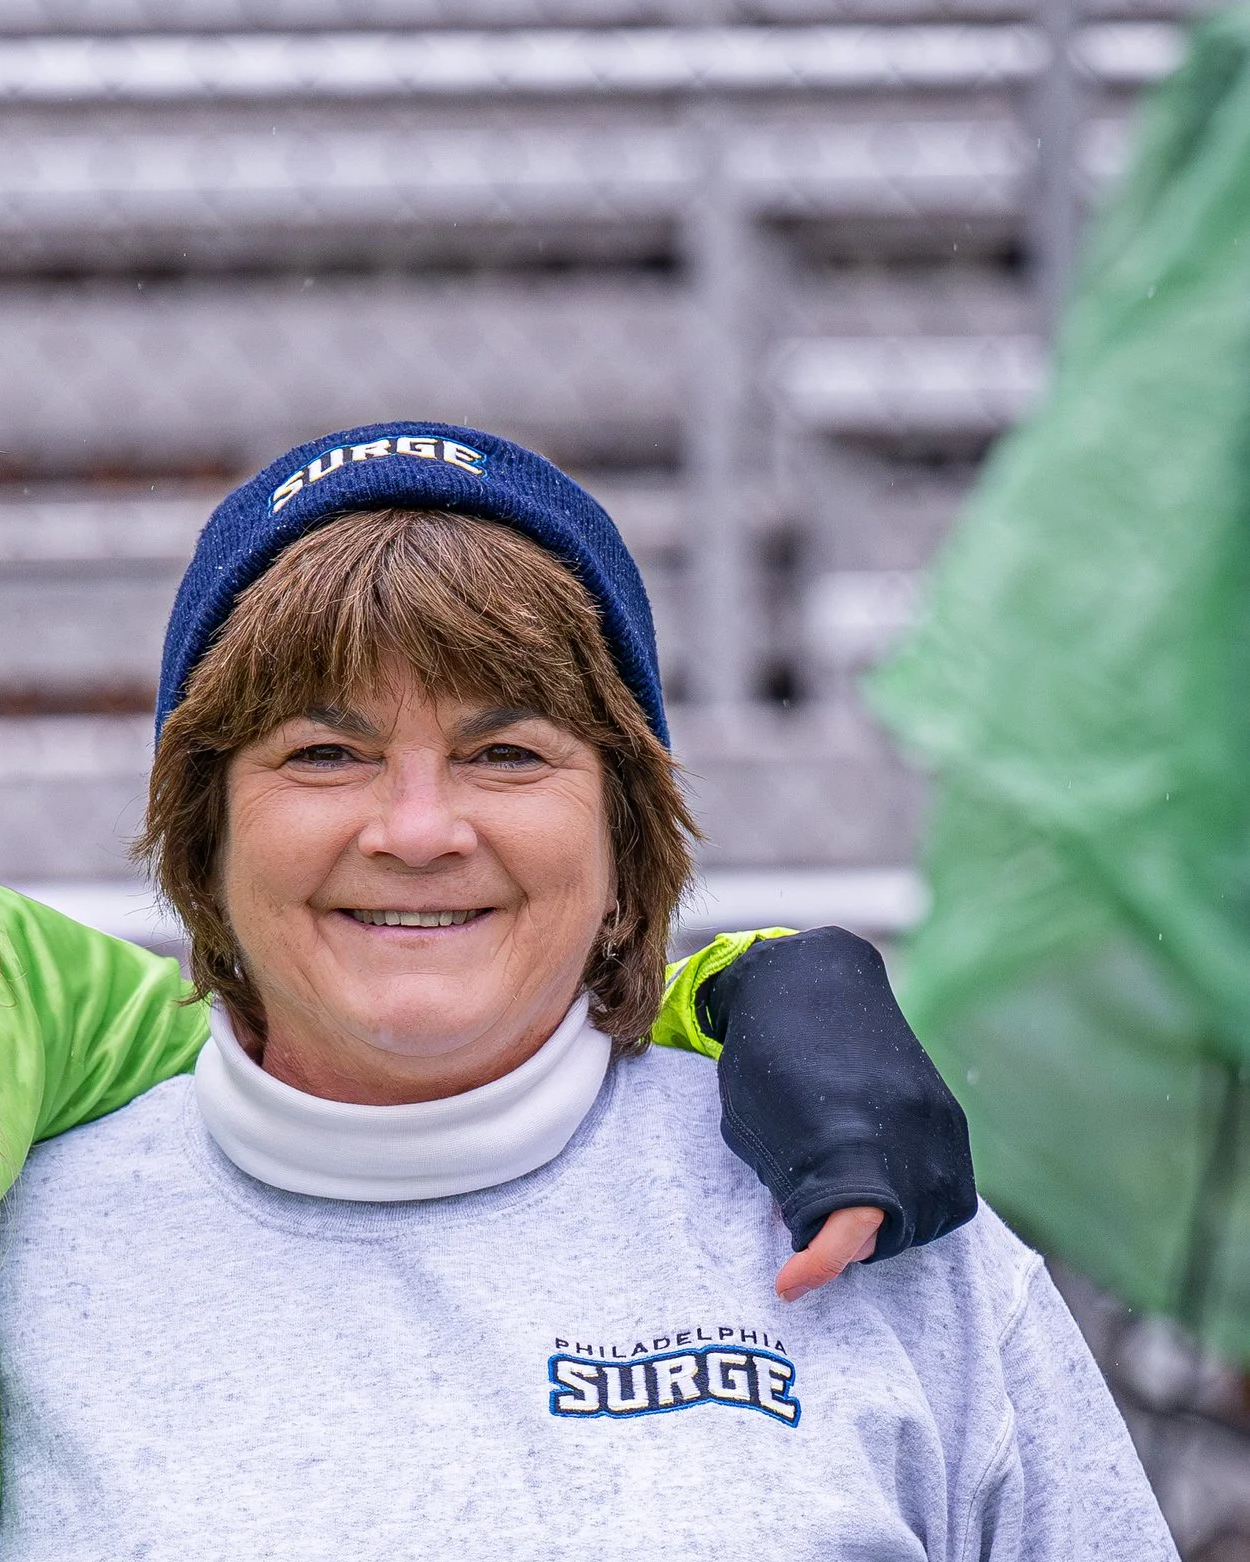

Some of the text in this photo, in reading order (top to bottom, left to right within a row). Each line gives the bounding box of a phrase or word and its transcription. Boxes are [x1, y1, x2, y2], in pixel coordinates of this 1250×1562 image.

[270, 436, 488, 513] SURGE
[555, 1326, 787, 1358] PHILADELPHIA
[553, 1349, 798, 1422] SURGE
